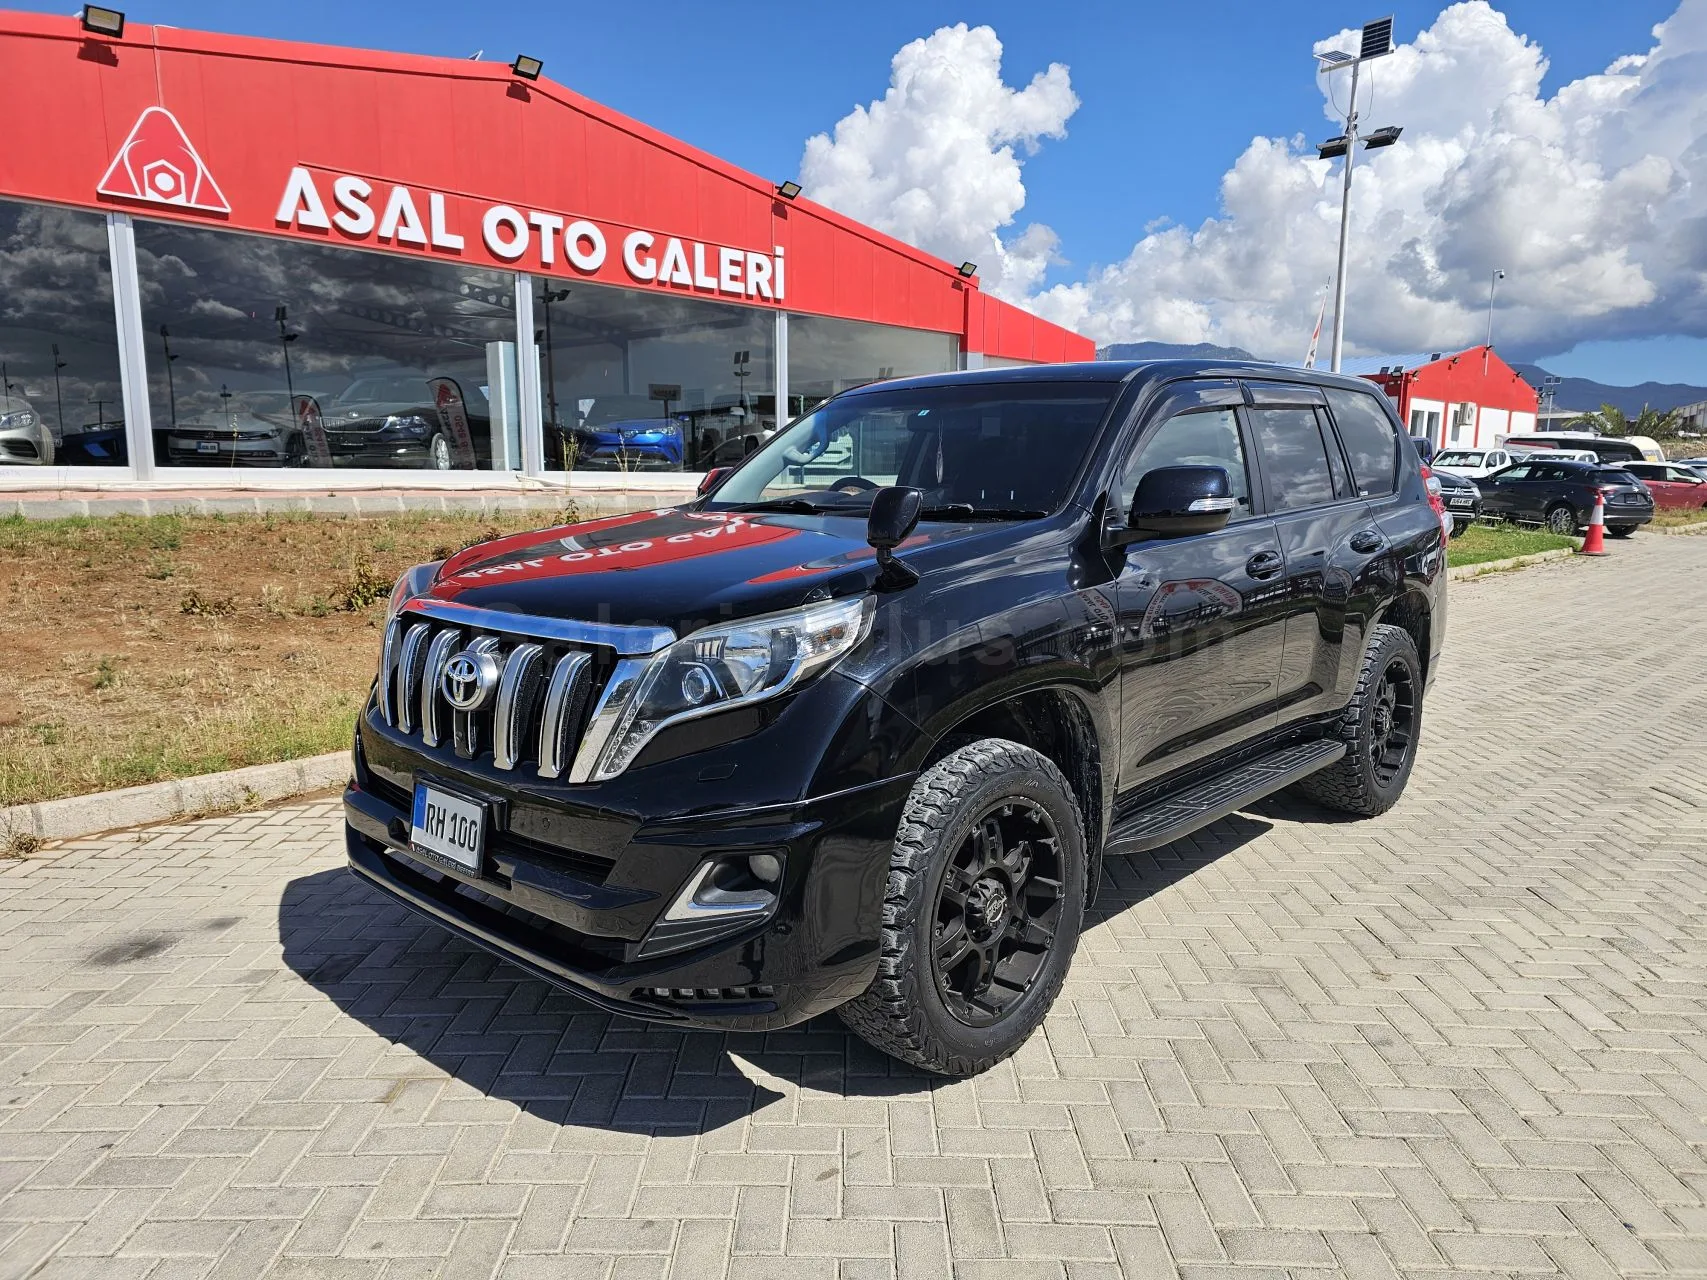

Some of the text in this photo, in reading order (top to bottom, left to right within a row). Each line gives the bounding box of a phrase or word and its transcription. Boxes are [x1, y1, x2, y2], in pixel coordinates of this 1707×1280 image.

[275, 166, 785, 300] ASAL OTO GALERİ
[425, 803, 478, 852] RH 100
